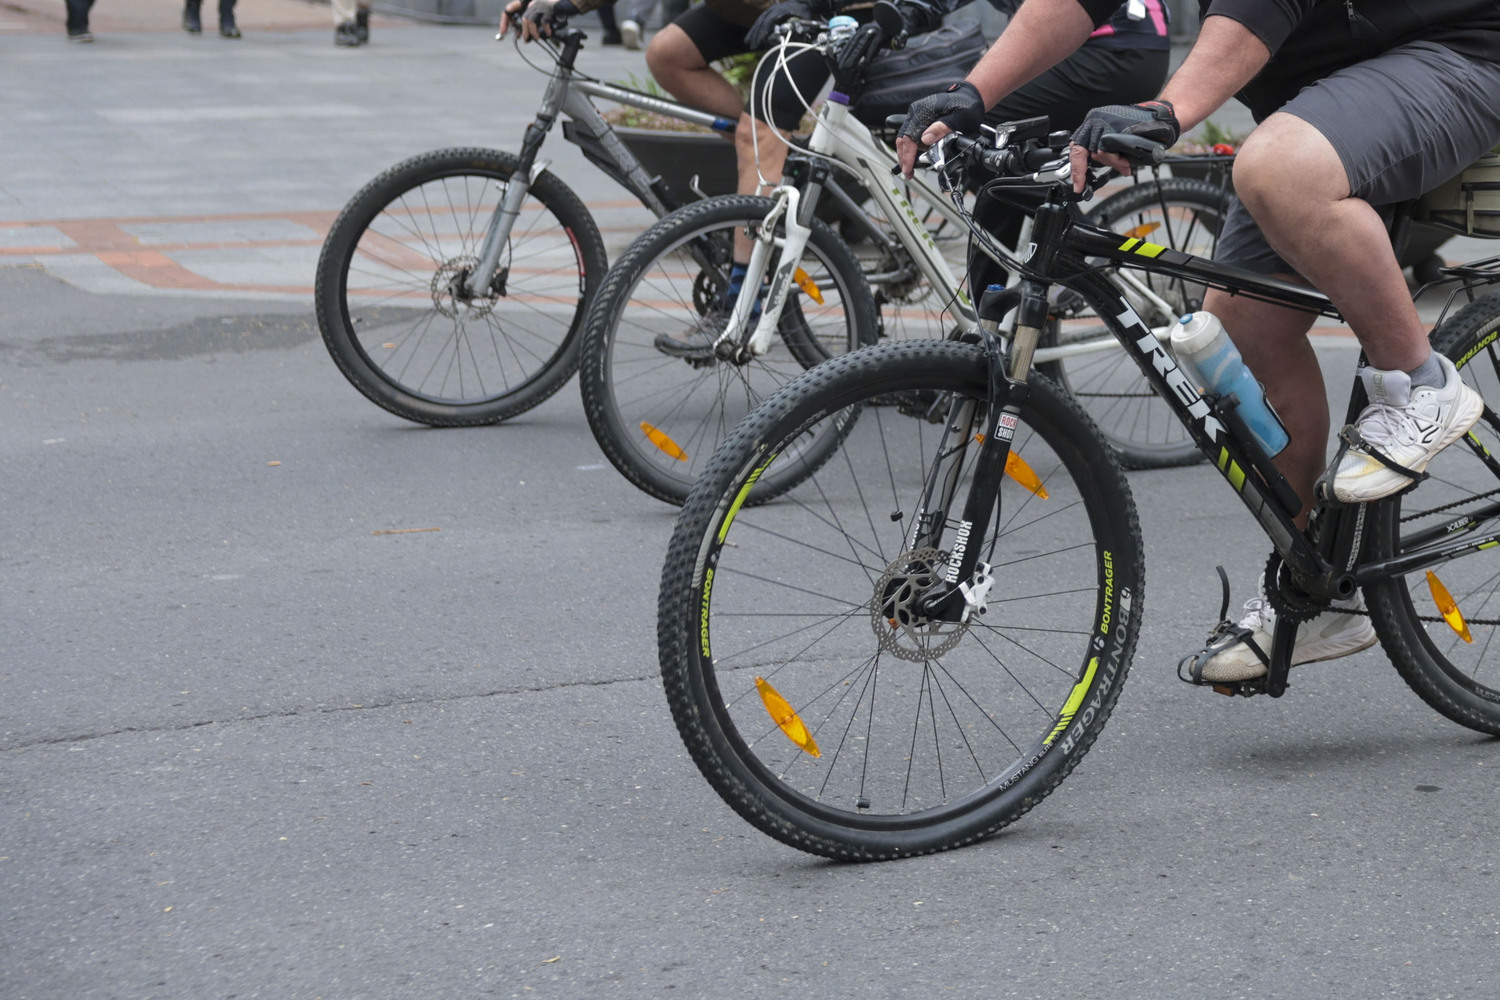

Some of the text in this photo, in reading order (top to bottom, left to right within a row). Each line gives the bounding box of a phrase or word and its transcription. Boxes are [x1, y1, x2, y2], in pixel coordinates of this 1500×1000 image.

[1115, 296, 1230, 443] TREK
[1456, 331, 1498, 370] BONTRAG
[945, 520, 973, 584] ROCKSHOX
[1101, 551, 1112, 634] BONTRAGER
[701, 568, 714, 658] BONTRAGER
[1061, 609, 1131, 756] BONTRAGER
[999, 756, 1039, 791] MUSTANG
